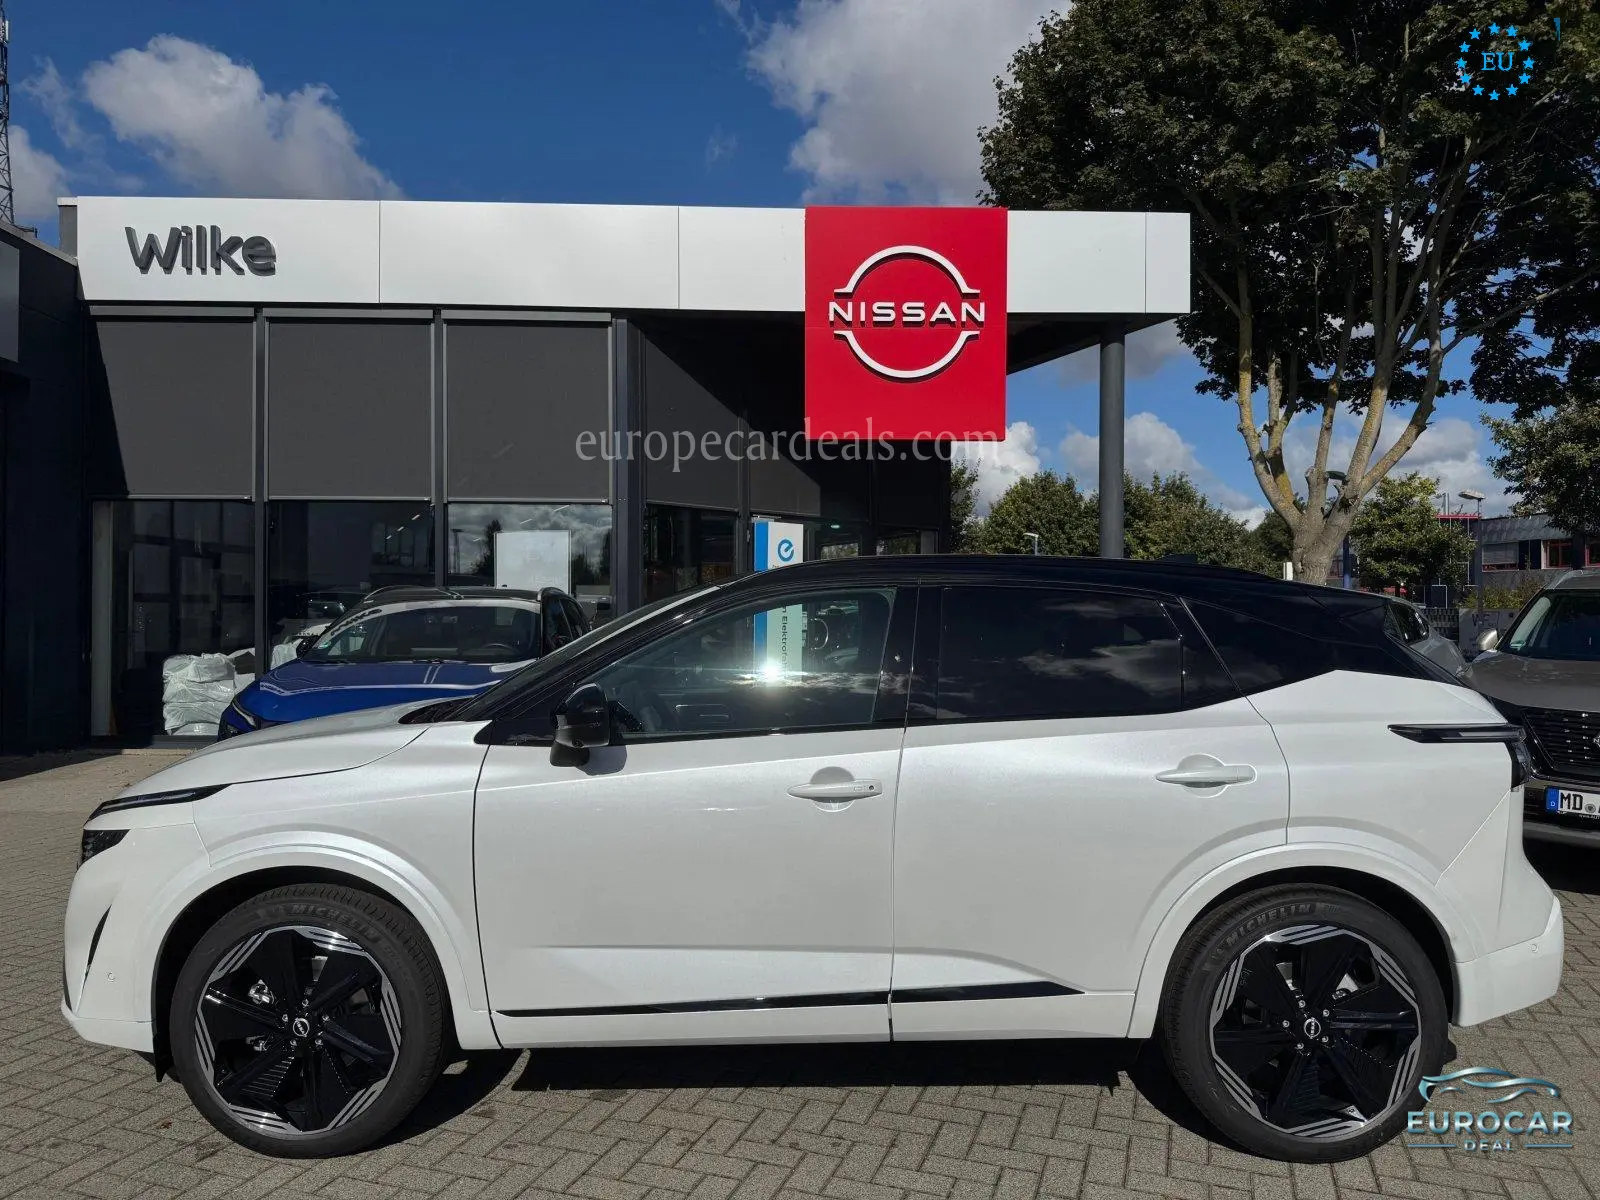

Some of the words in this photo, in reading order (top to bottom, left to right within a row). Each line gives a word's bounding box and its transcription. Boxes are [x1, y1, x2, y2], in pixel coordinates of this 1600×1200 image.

[125, 225, 276, 276] Wilke
[828, 301, 985, 324] NISSAN
[1226, 903, 1311, 946] MICHELIN
